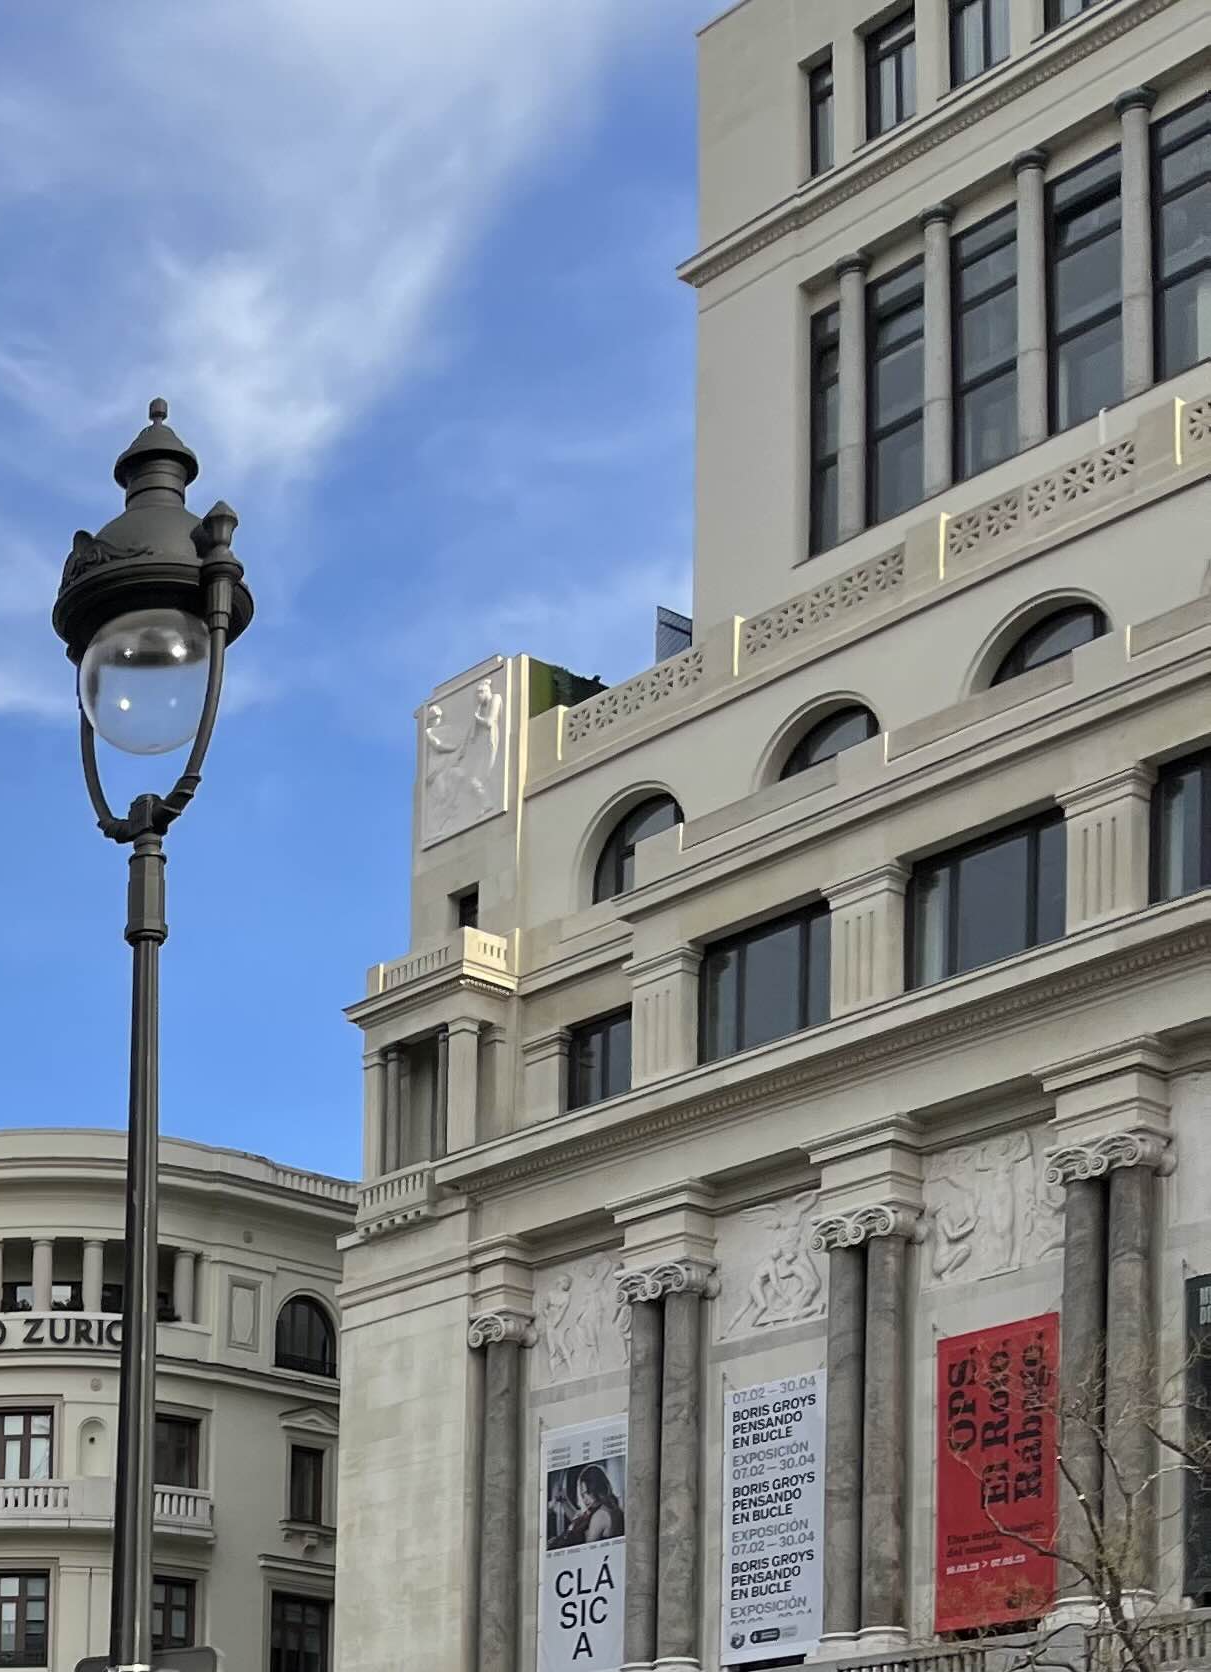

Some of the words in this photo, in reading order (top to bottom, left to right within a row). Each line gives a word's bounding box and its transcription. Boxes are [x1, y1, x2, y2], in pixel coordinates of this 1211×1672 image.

[22, 1318, 124, 1347] ZURIC
[733, 1387, 765, 1404] 07.02
[779, 1376, 816, 1393] 30.04
[732, 1405, 770, 1422] BORIS
[773, 1394, 816, 1413] GROYS
[732, 1411, 803, 1435] PENSANDO
[732, 1436, 749, 1449] EN
[752, 1426, 793, 1445] BUCLE
[733, 1464, 765, 1480] 07.02
[779, 1453, 815, 1470] 30.04
[732, 1481, 769, 1498] BORIS
[772, 1471, 815, 1490] GROYS
[732, 1488, 802, 1512] PENSANDO
[732, 1511, 749, 1525] EN
[752, 1503, 793, 1521] BUCLE
[731, 1540, 765, 1556] 07.02
[778, 1530, 815, 1548] 30.04
[731, 1557, 769, 1574] BORIS
[772, 1549, 814, 1567] GROYS
[555, 1555, 615, 1598] CLÁ
[731, 1565, 801, 1588] PENSANDO
[731, 1587, 748, 1601] EN
[751, 1580, 792, 1598] BUCLE
[560, 1596, 608, 1629] SIC
[730, 1595, 807, 1619] EXPOSICIÓN
[572, 1631, 593, 1660] A
